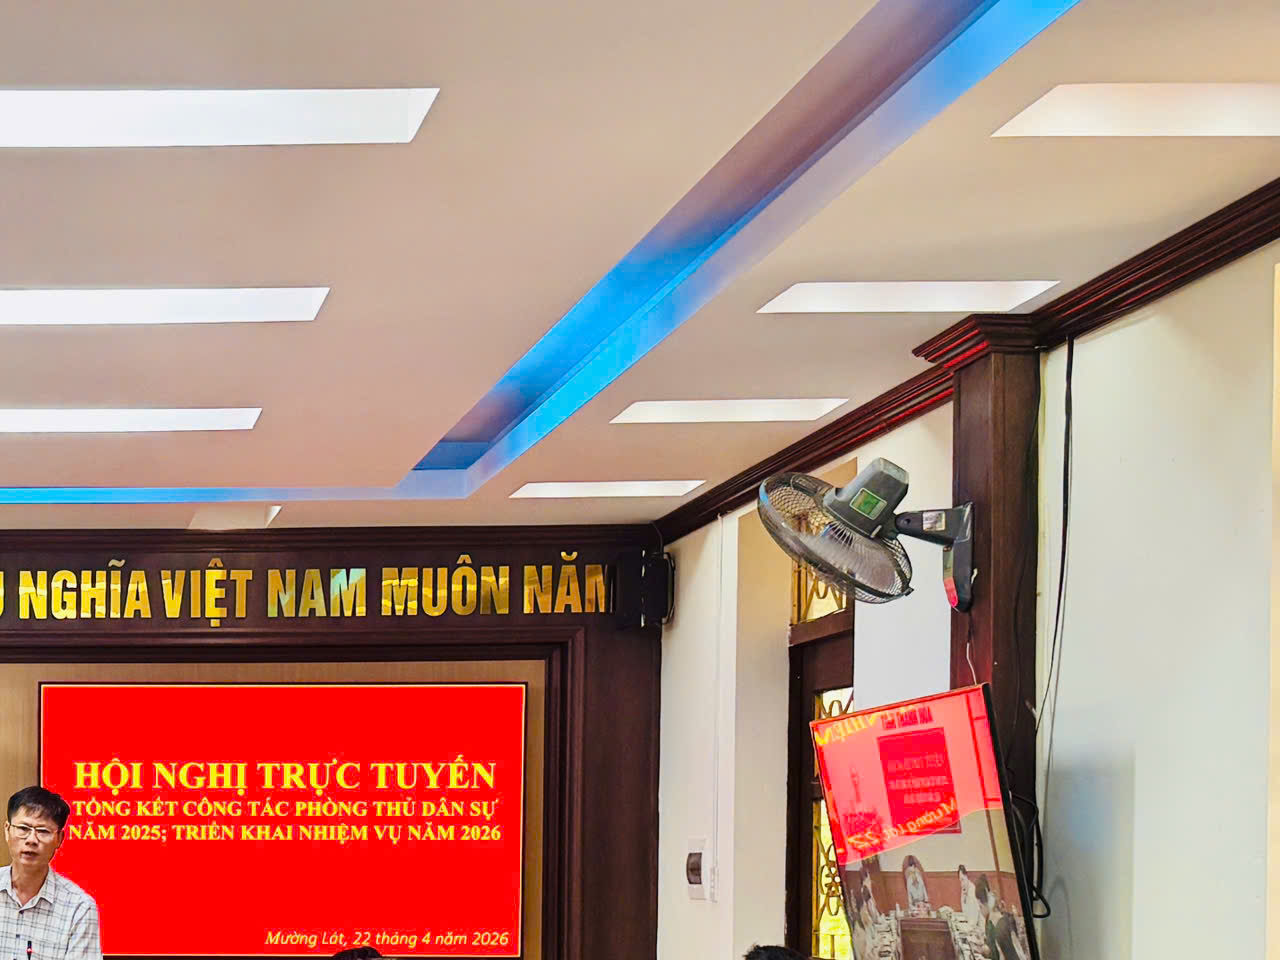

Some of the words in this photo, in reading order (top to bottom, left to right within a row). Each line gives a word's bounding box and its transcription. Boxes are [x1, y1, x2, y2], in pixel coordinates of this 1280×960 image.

[18, 558, 153, 620] NGHĨA
[160, 557, 254, 628] VIỆT
[267, 568, 368, 618] NAM
[381, 554, 510, 617] MUÔN
[523, 551, 616, 614] NĂM
[74, 757, 144, 796] HỘI
[152, 761, 248, 796] NGHỊ
[256, 757, 361, 796] TRỰC
[369, 754, 497, 789] TUYẾN
[72, 796, 131, 816] TỔNG
[137, 796, 179, 816] KẾT
[183, 796, 242, 816] CÔNG
[247, 796, 289, 816] TÁC
[295, 796, 368, 816] PHÒNG
[373, 796, 416, 816] THỦ
[421, 796, 464, 816] DÂN
[469, 797, 500, 820] SỰ
[68, 820, 115, 841] NĂM
[120, 824, 168, 843] 2025;
[171, 820, 235, 841] TRIỂN
[241, 824, 294, 840] KHAI
[299, 823, 369, 845] NHIỆM
[373, 824, 403, 845] VỤ
[407, 821, 455, 841] NĂM
[460, 824, 502, 841] 2026
[264, 930, 318, 949] Mường
[322, 931, 348, 946] Lát,
[353, 931, 371, 946] 22
[375, 931, 418, 949] tháng
[421, 931, 431, 945] 4
[435, 931, 468, 945] năm
[472, 931, 510, 946] 2026
